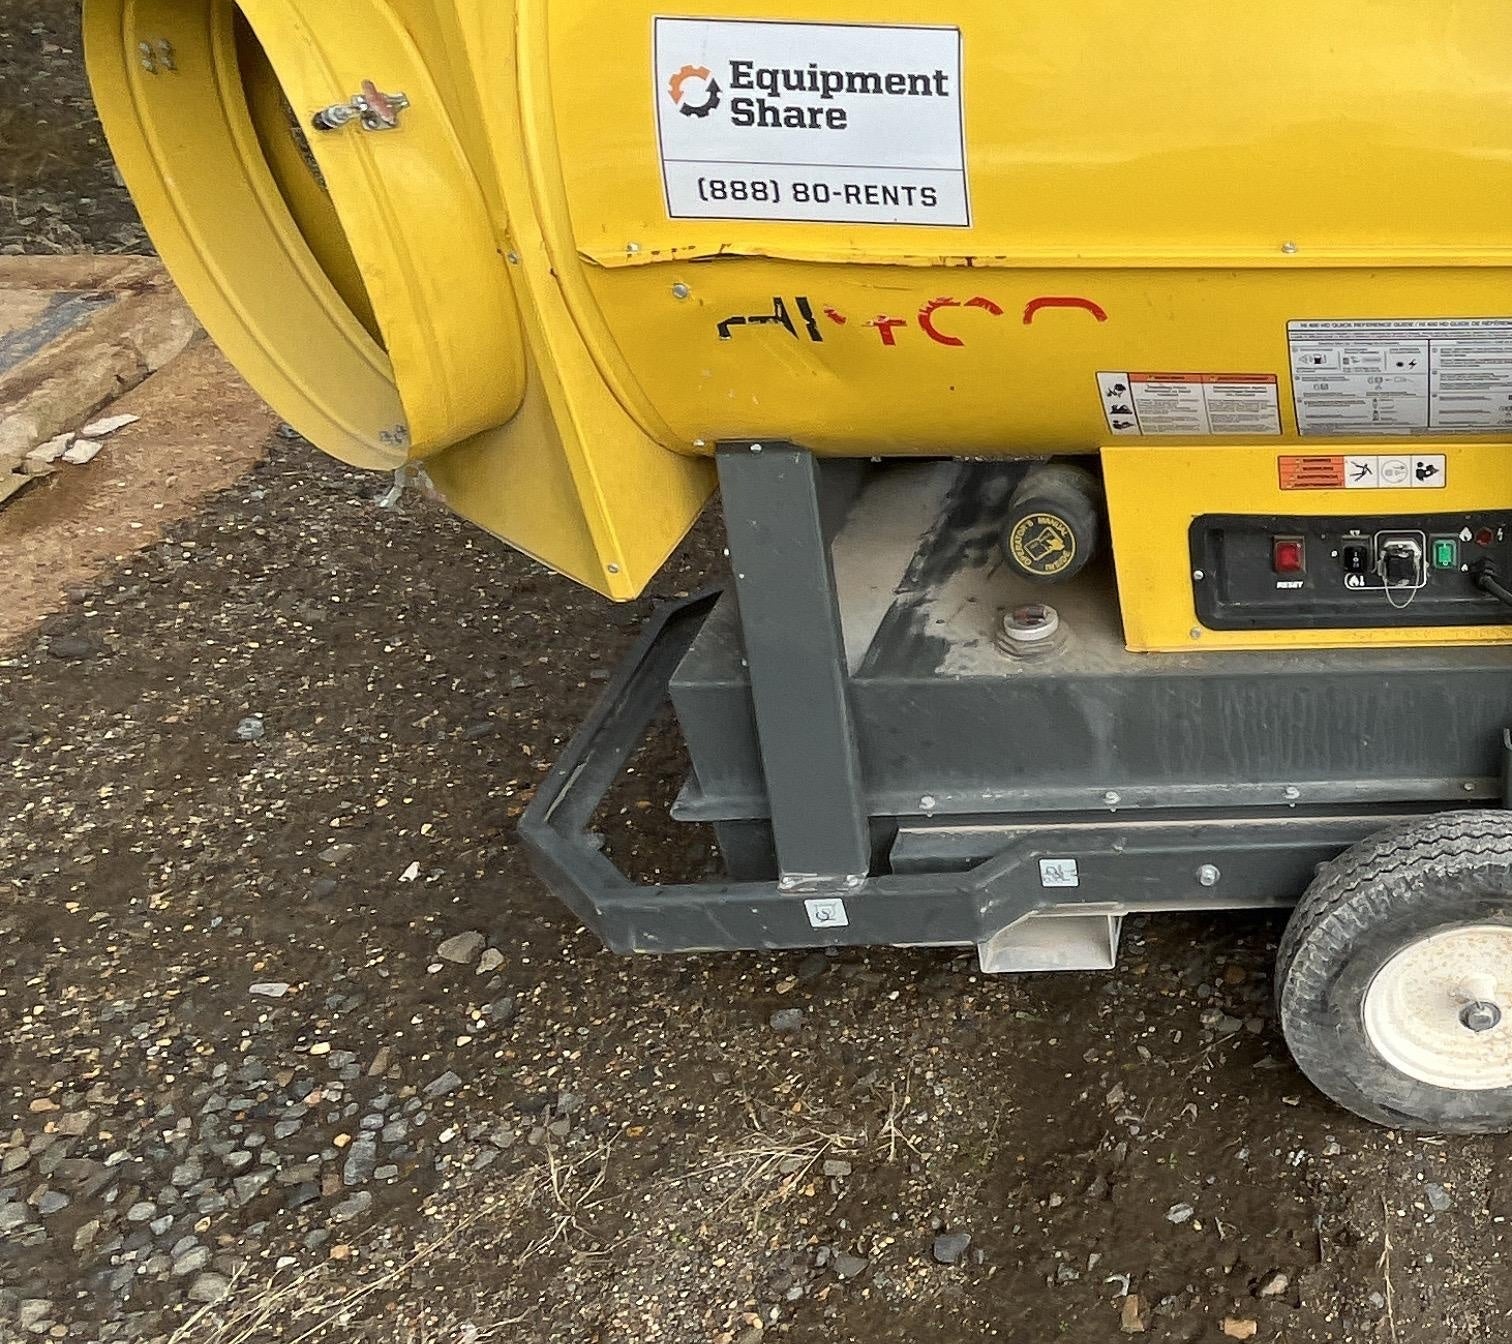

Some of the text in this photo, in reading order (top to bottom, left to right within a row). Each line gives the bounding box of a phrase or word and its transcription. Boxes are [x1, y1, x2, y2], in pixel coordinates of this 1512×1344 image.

[728, 59, 950, 100] Equipment
[730, 96, 849, 131] Share
[696, 175, 939, 209] (888) 80-RENTS
